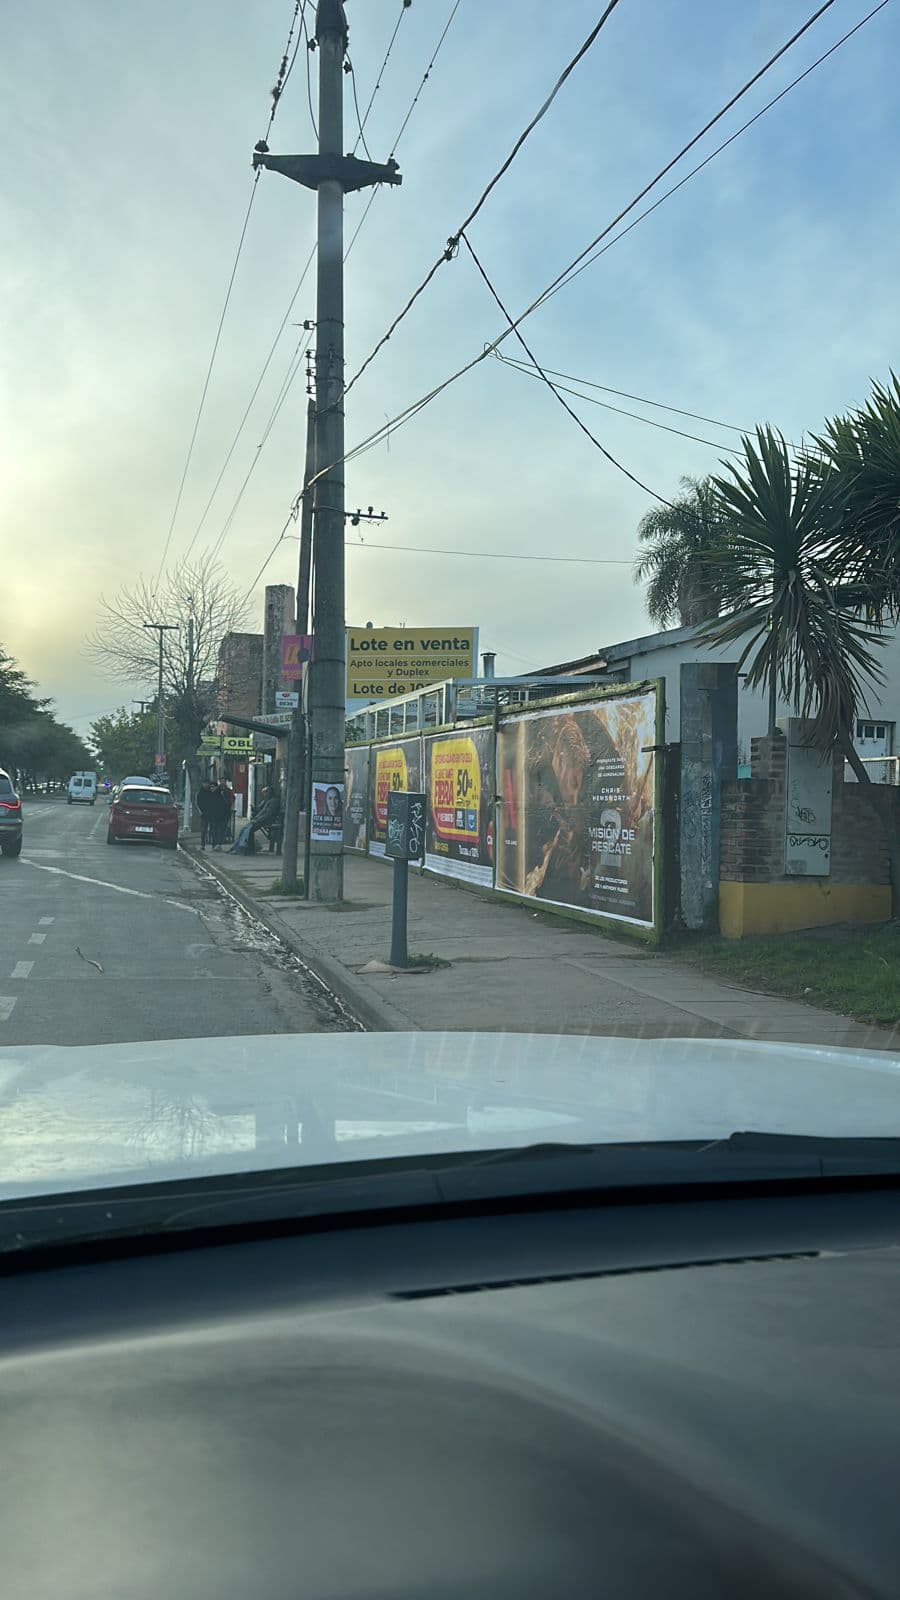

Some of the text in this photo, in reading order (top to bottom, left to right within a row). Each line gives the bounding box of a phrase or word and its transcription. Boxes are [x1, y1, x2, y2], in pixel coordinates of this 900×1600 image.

[350, 637, 470, 651] Lote en venta
[350, 658, 469, 668] Apto locales comerciales
[387, 668, 430, 677] y Duplex
[353, 682, 385, 694] Lote
[388, 682, 406, 694] de
[621, 828, 635, 841] DE
[592, 841, 632, 855] RESCATE
